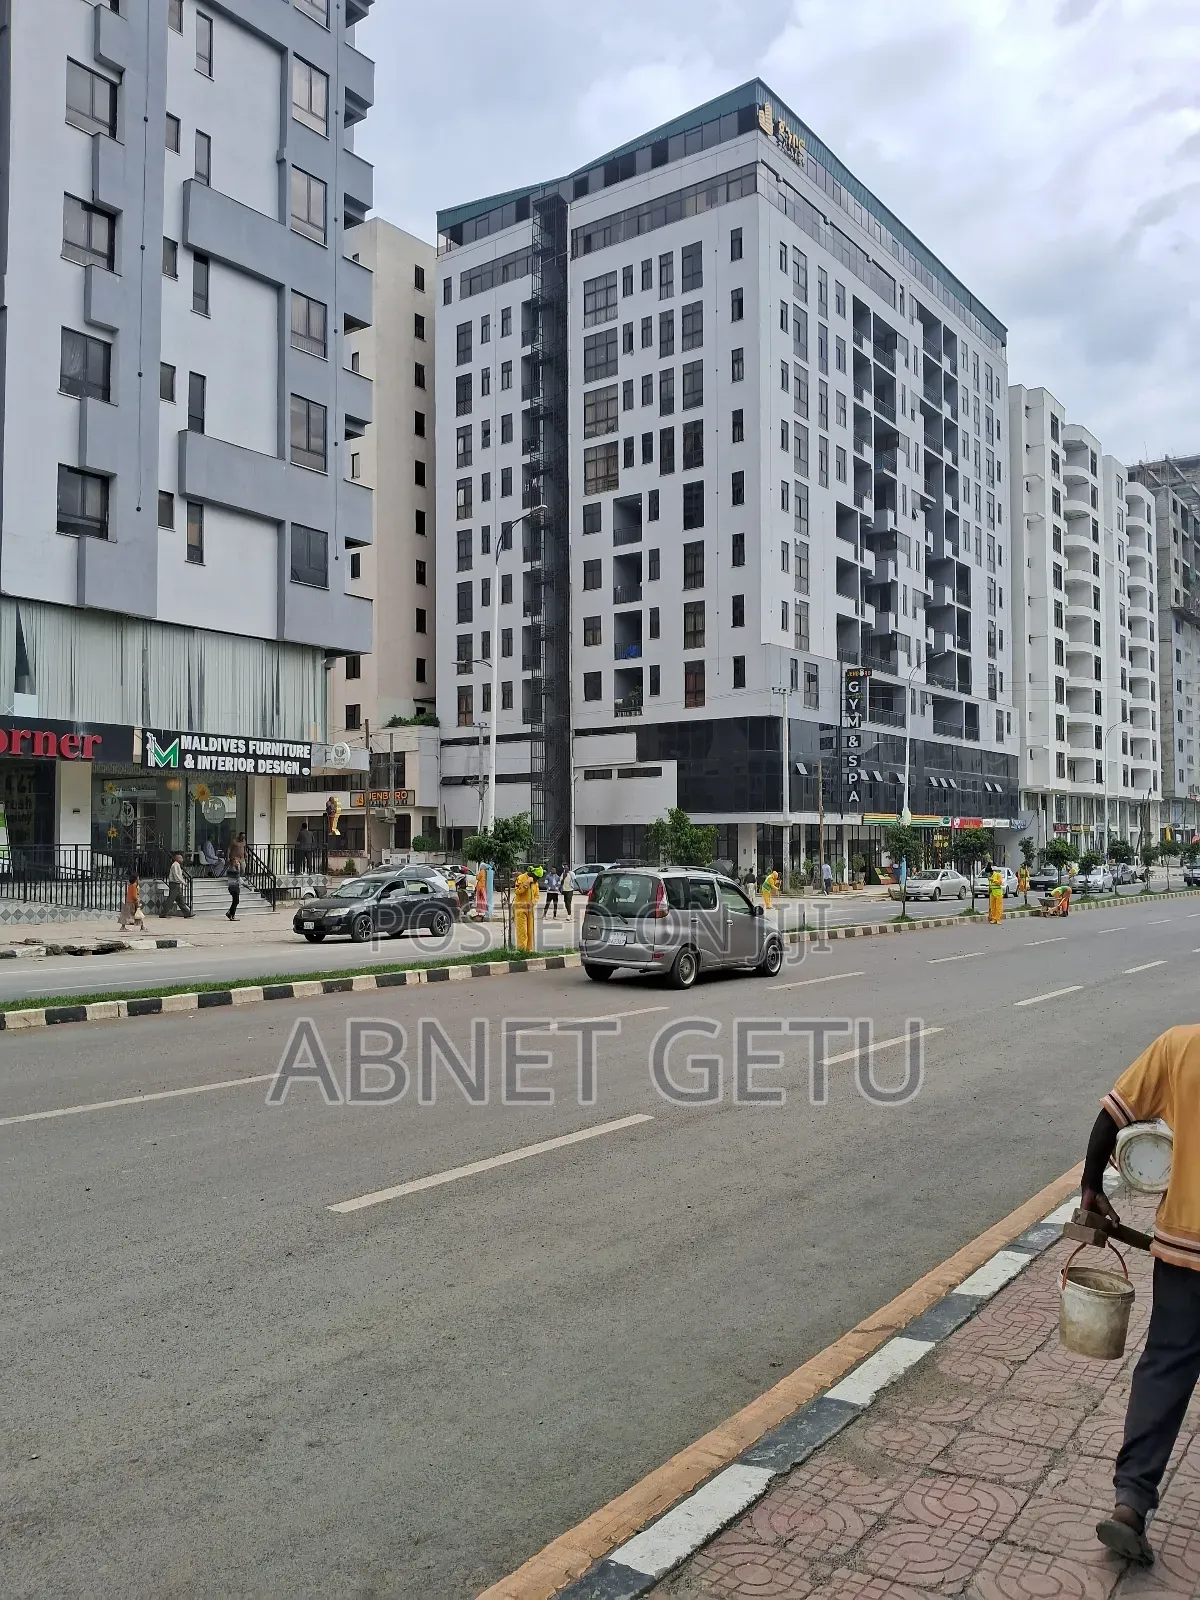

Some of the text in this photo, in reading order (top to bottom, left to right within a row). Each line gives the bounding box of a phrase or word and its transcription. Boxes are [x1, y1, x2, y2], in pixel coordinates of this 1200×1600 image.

[180, 734, 311, 759] MALDIVES FURNITURE
[848, 681, 860, 803] GYM & SPA
[183, 754, 300, 775] & INTERIOR DESIGN
[368, 791, 408, 801] JENBRO
